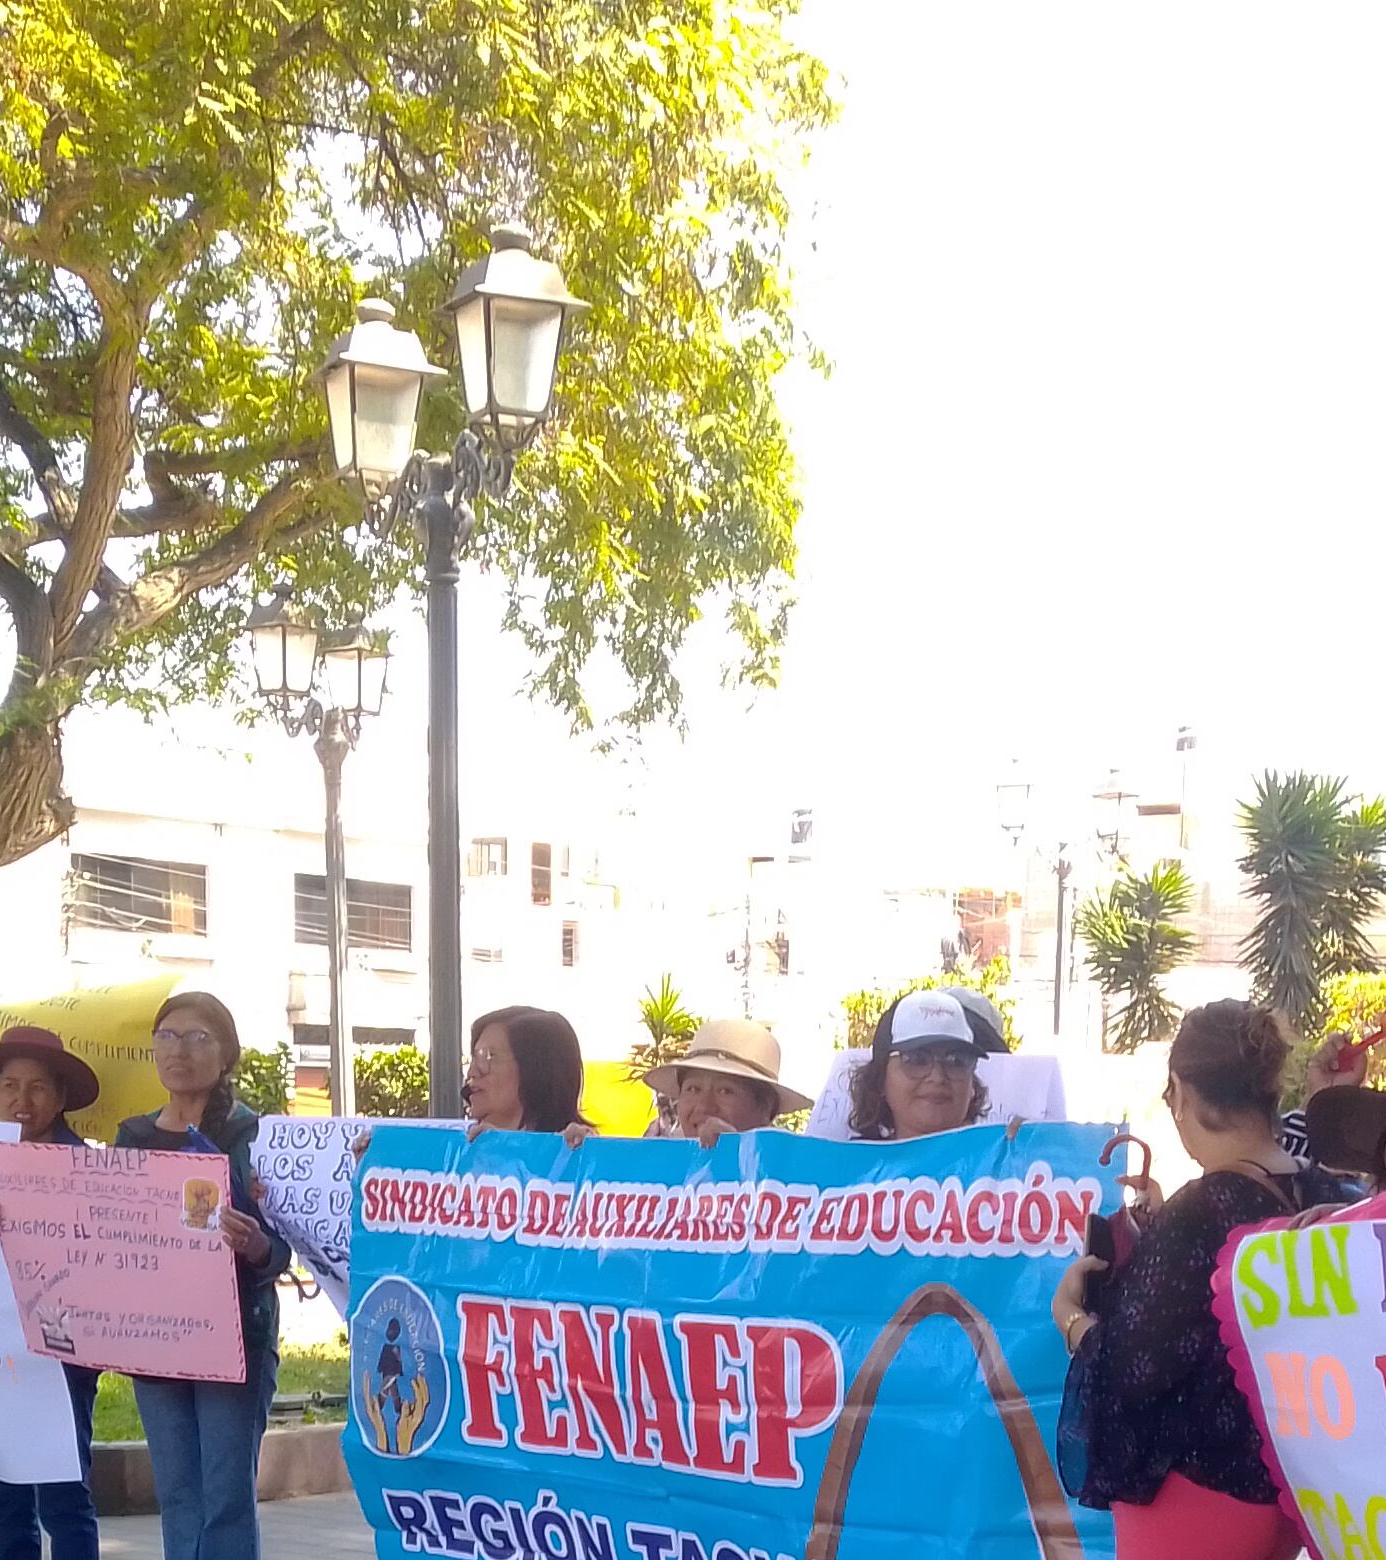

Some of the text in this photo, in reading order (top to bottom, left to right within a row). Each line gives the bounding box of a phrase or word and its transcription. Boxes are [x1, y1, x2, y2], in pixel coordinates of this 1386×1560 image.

[268, 1122, 335, 1150] HOY
[71, 1146, 148, 1170] FENAEP
[257, 1154, 314, 1181] LOS
[363, 1177, 515, 1230] SINDICATO
[568, 1190, 750, 1243] AUXILIARES
[753, 1191, 812, 1241] DE
[810, 1173, 1094, 1246] EDUCACIÓN
[73, 1223, 91, 1239] EL
[67, 1249, 87, 1267] LEY
[114, 1253, 159, 1271] 31923
[1235, 1224, 1359, 1330] SIN
[457, 1301, 839, 1483] FENAEP
[1264, 1351, 1356, 1441] NO
